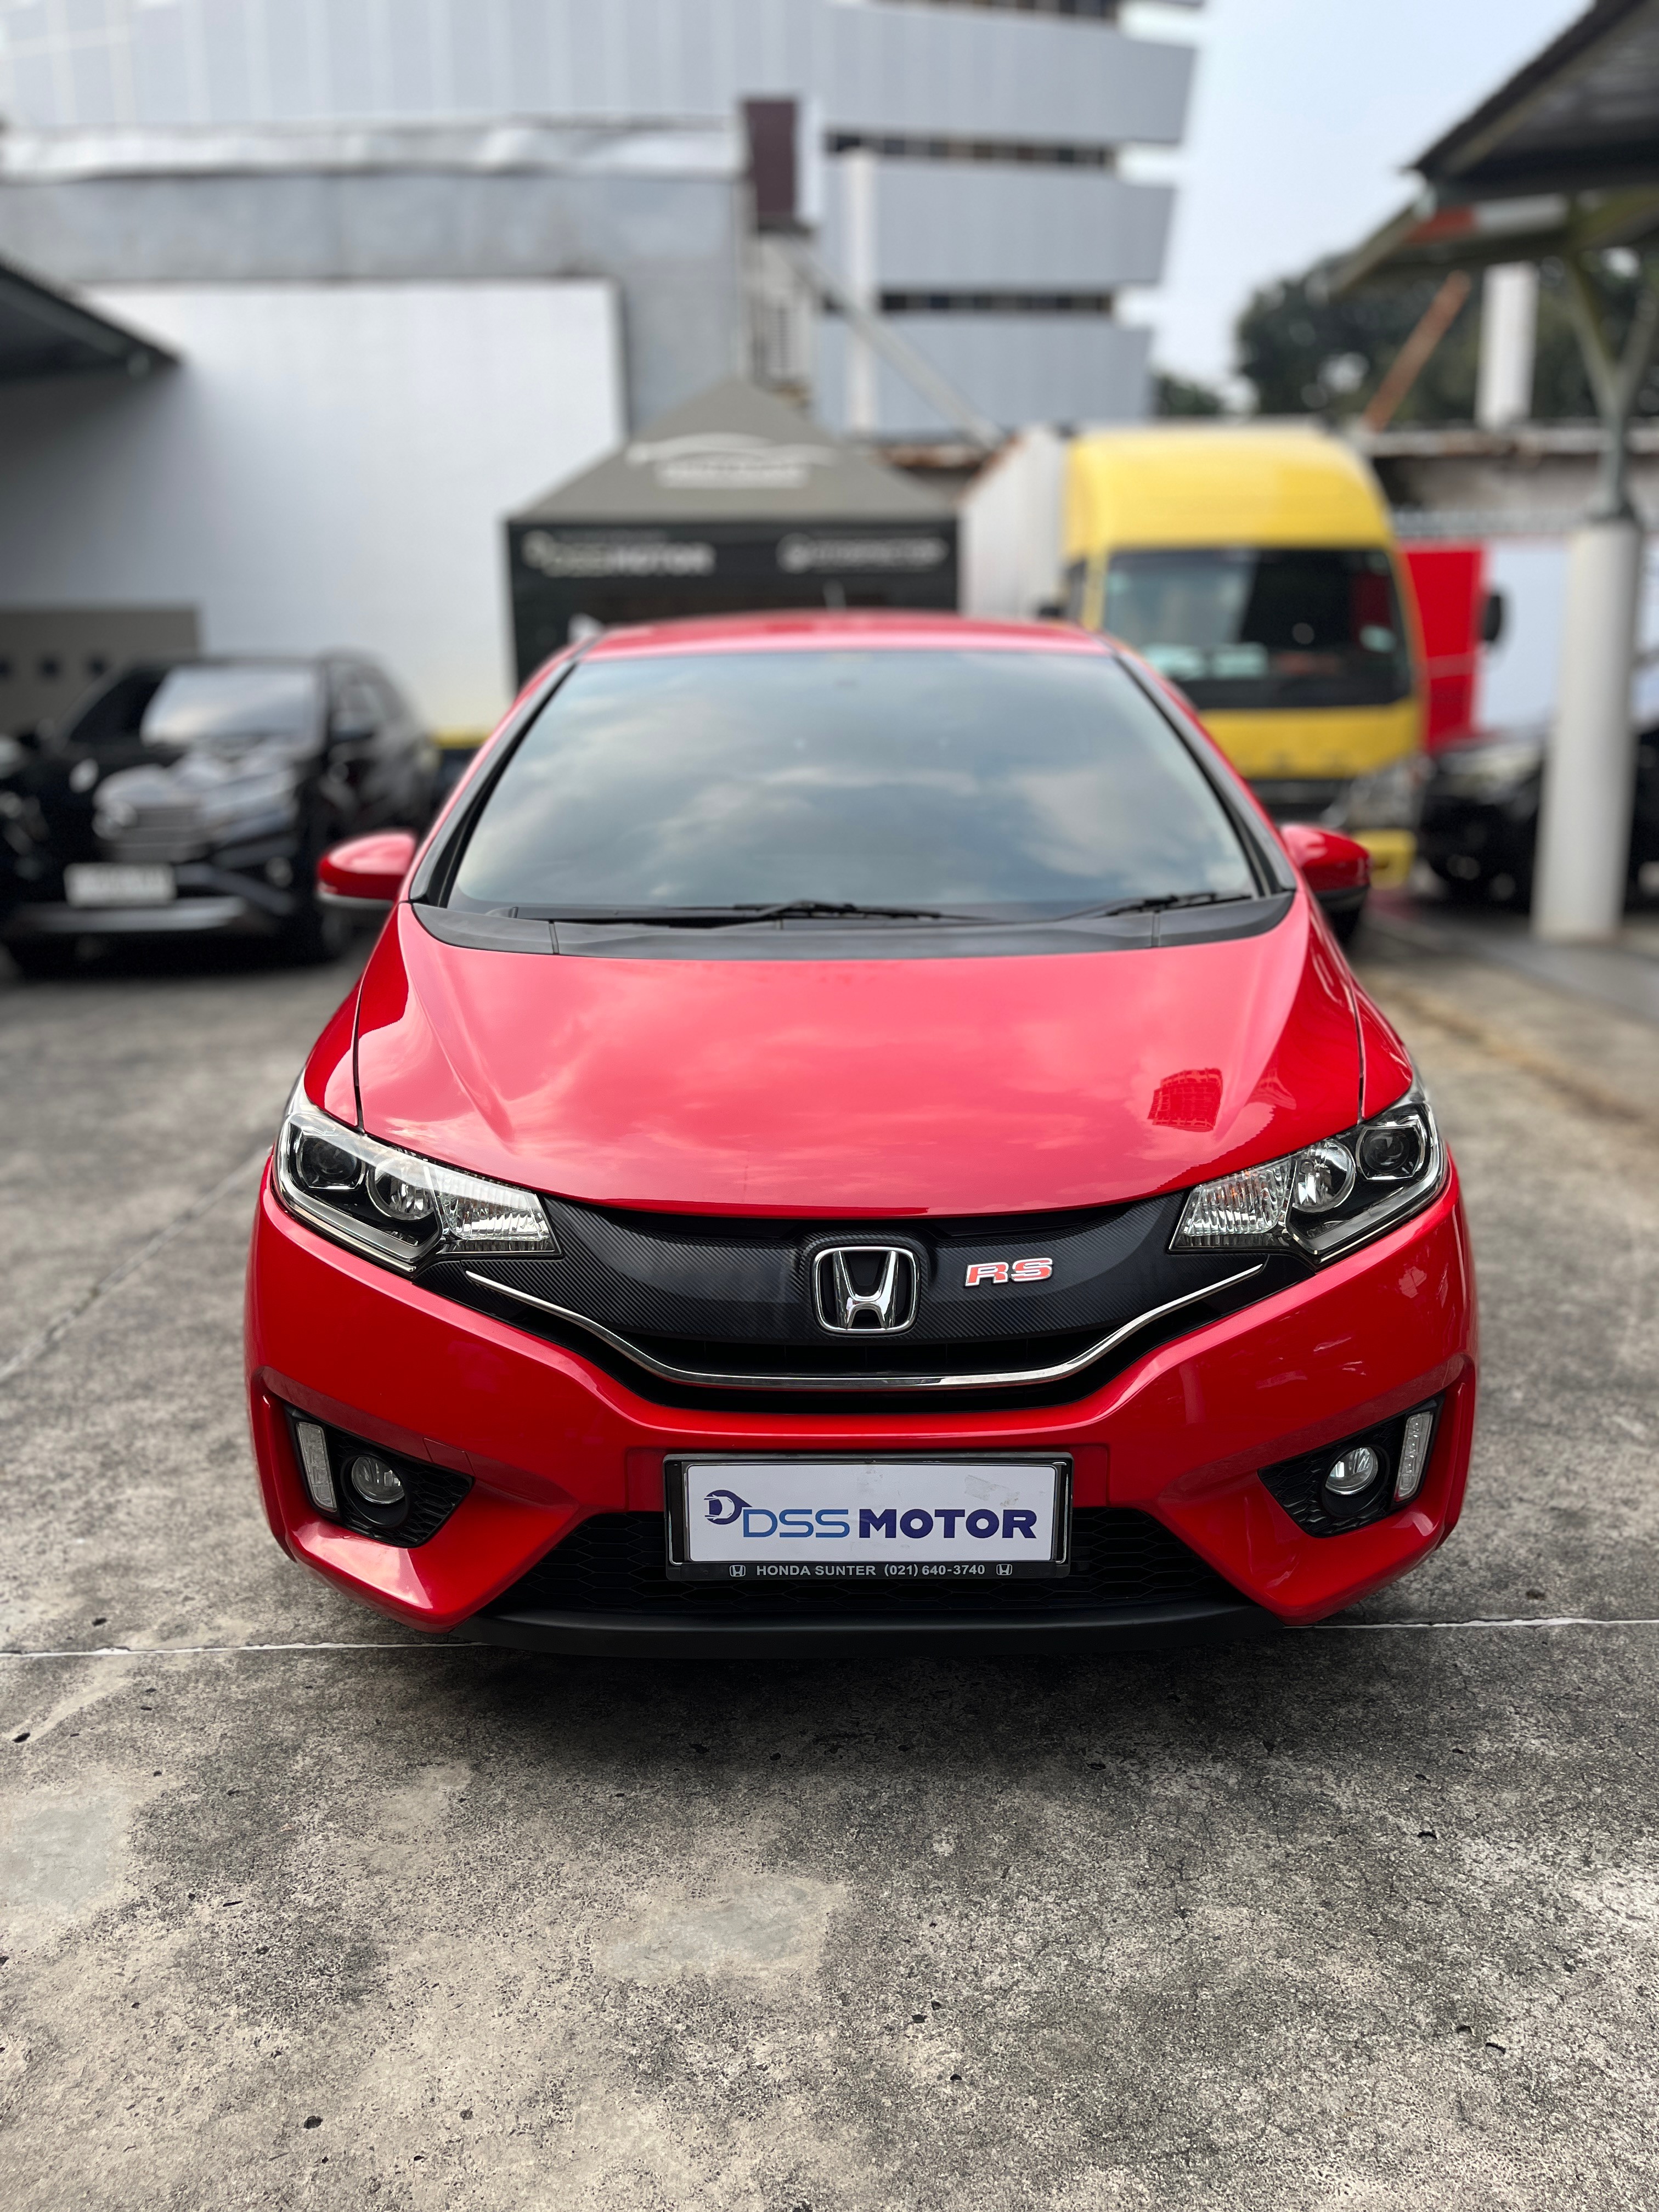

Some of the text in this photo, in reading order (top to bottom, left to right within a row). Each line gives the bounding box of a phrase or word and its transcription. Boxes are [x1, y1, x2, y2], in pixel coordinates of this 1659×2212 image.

[964, 1257, 1054, 1287] RS
[743, 1508, 1037, 1539] DSS MOTOR
[756, 1564, 985, 1577] HONDA SUNTER (021) 640-3740
